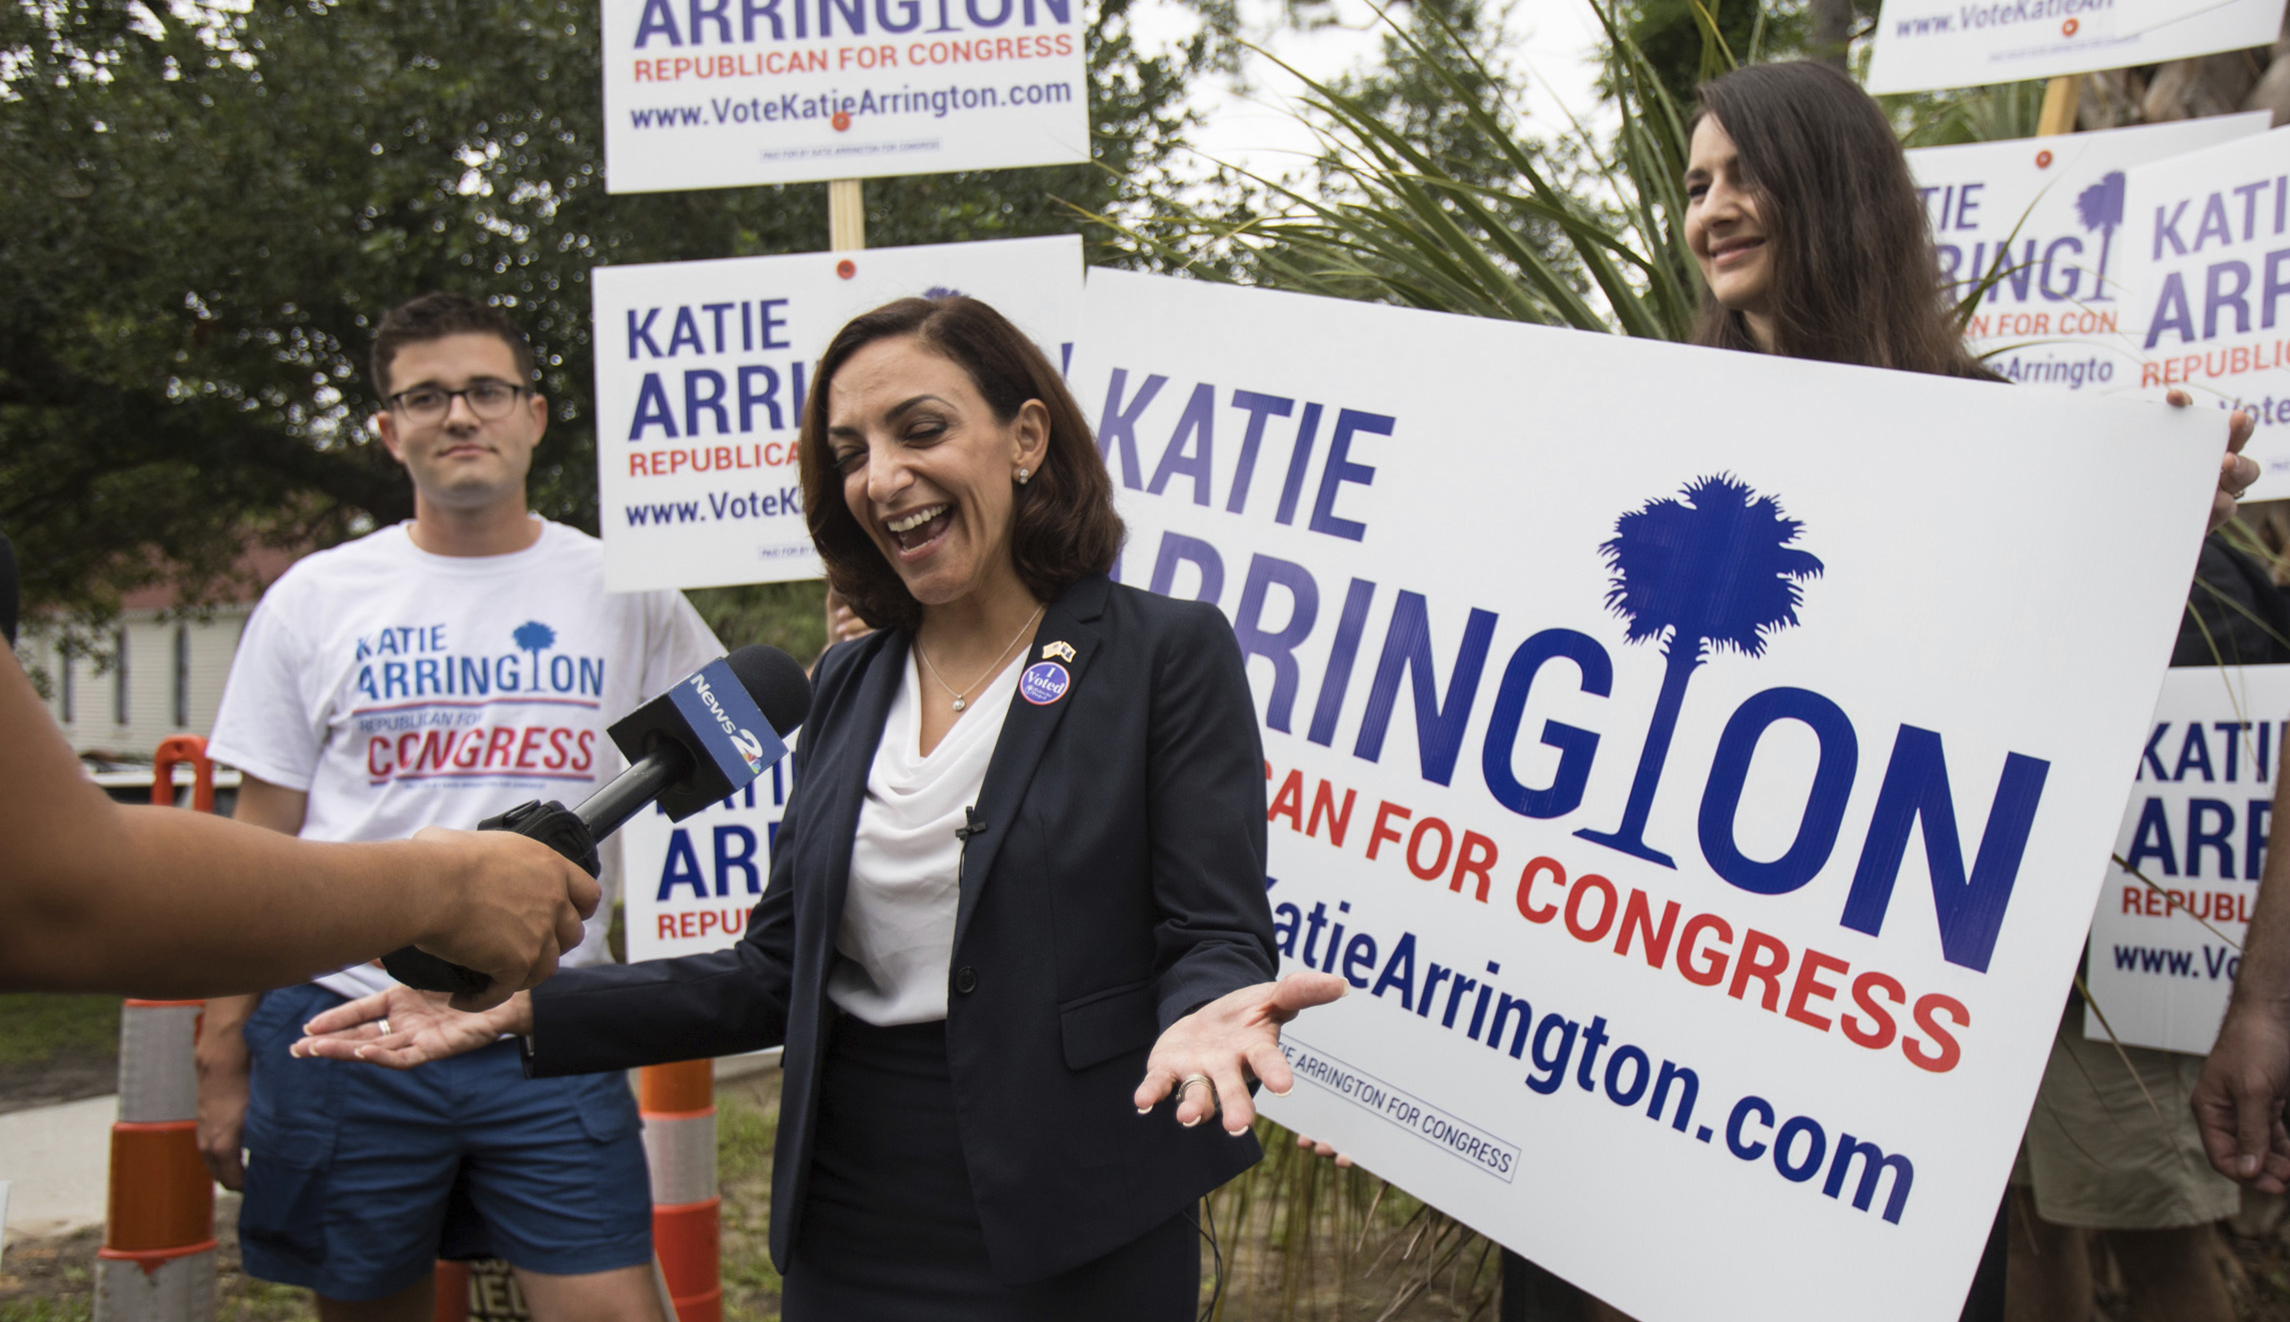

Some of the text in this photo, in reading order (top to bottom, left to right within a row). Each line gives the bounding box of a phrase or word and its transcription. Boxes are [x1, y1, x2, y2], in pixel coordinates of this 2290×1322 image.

[634, 34, 1072, 82] REPUBLICAN FOR CONGRESS
[631, 82, 1071, 129] www.VoteKatieArrington.com
[626, 299, 791, 361] KATIE
[1997, 312, 2050, 337] FOR
[1099, 366, 1397, 543] KATIE
[356, 624, 448, 662] KATIE
[359, 653, 605, 700] ARRINGTON
[1027, 670, 1066, 694] Voted
[1046, 667, 1056, 678] I
[359, 711, 453, 731] REPUBLICAN
[368, 727, 596, 777] CONGRESS
[1365, 800, 1500, 904] FOR
[1515, 856, 1971, 1074] CONGRESS
[1266, 874, 1916, 1227] atieArrington.com
[1295, 1053, 1388, 1110] ARRINGTON
[1386, 1097, 1421, 1128] FOR
[1421, 1114, 1513, 1174] CONGRESS
